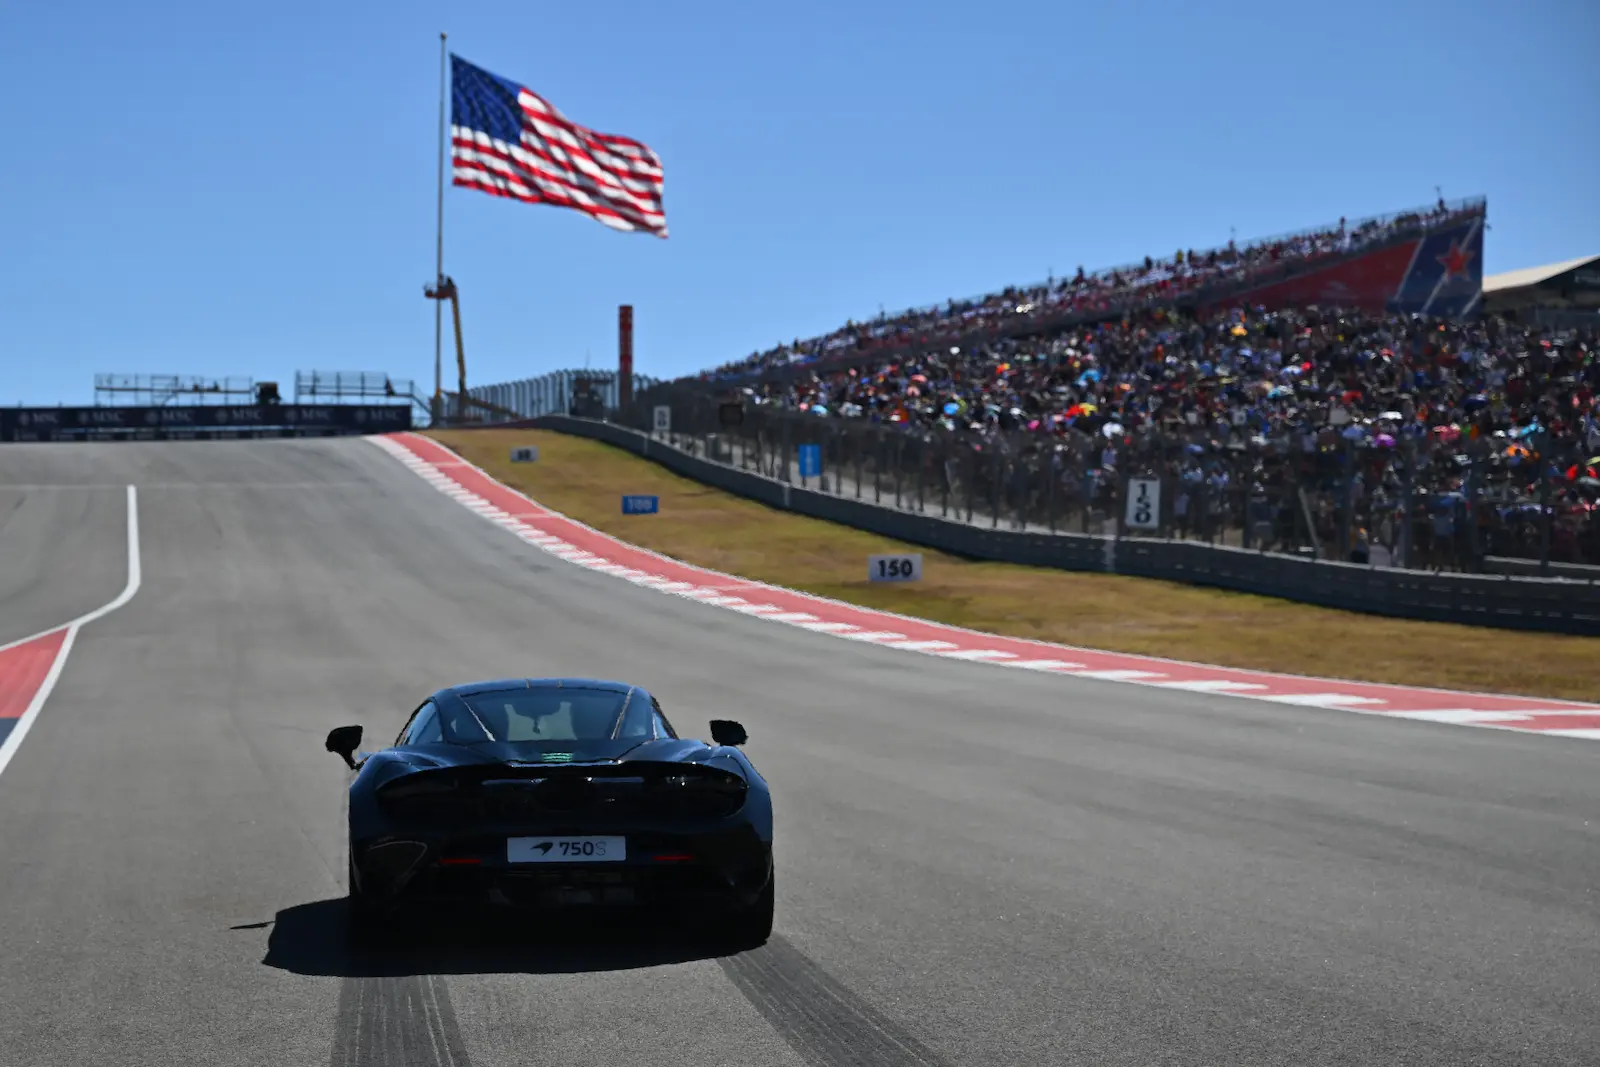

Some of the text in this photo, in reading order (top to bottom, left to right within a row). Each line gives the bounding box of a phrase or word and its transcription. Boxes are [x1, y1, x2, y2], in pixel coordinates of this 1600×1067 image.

[1135, 483, 1151, 523] 150
[878, 558, 913, 578] 150
[559, 841, 607, 856] 750S
